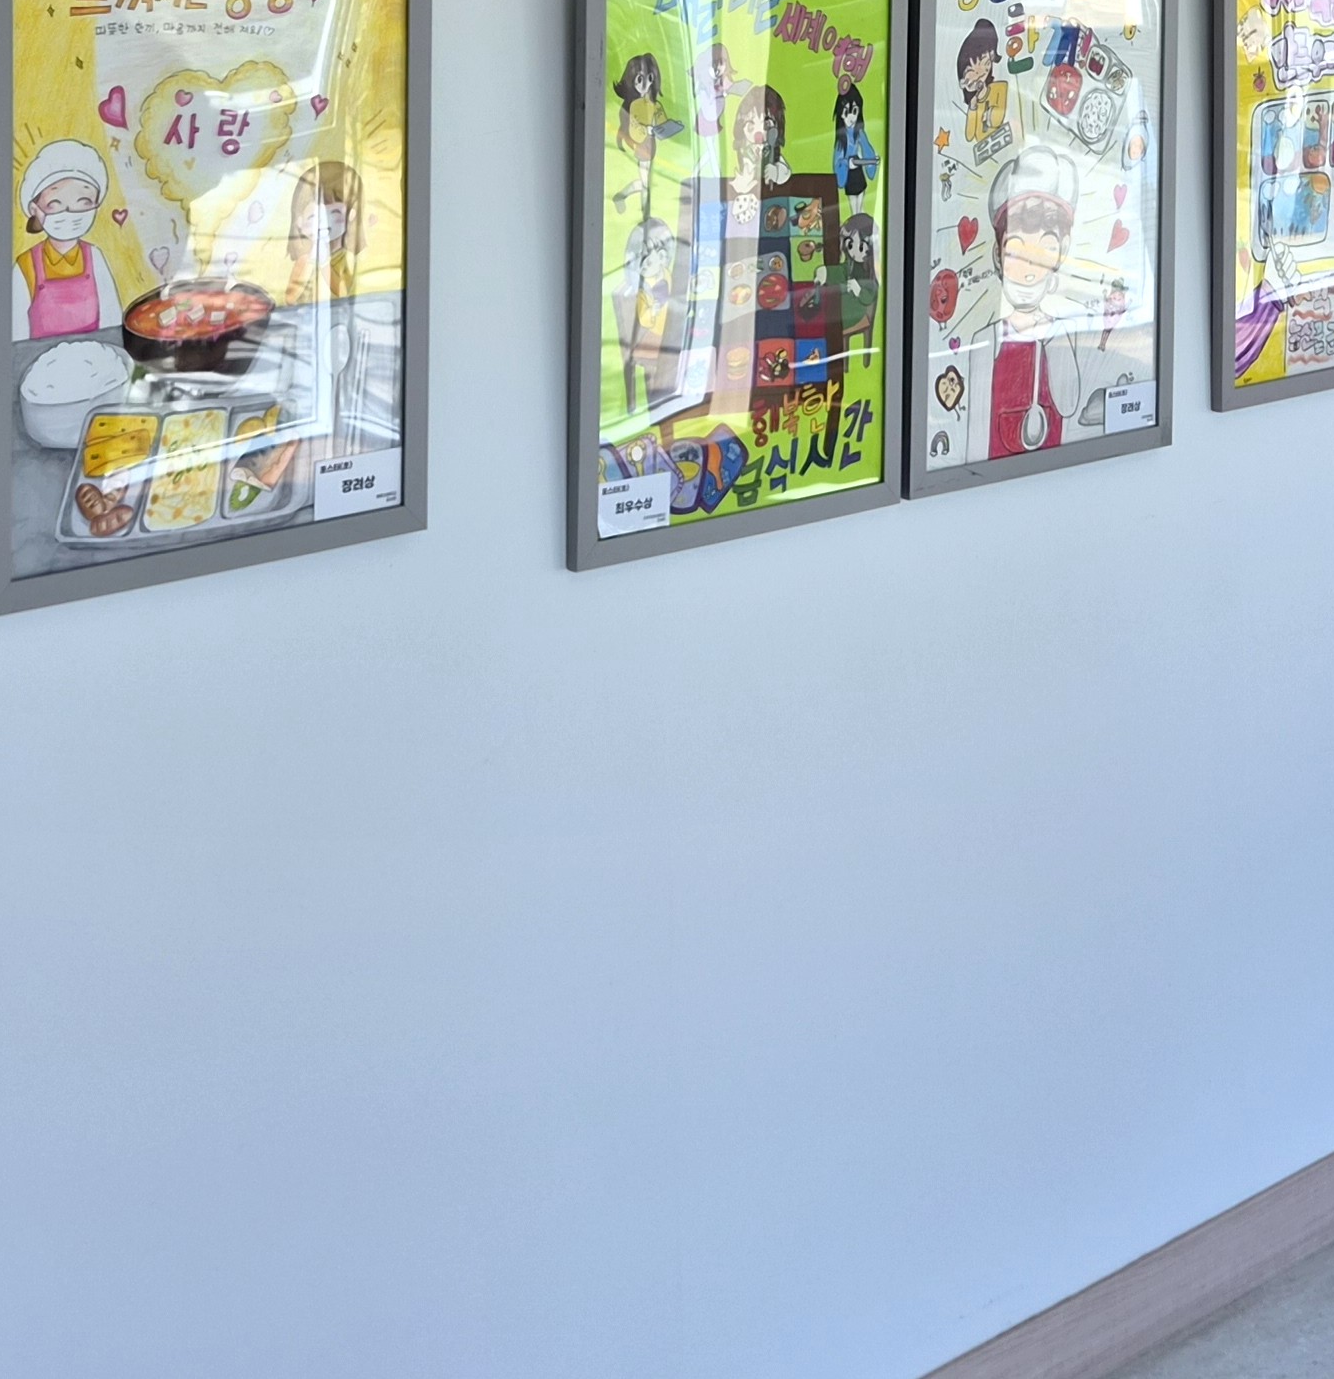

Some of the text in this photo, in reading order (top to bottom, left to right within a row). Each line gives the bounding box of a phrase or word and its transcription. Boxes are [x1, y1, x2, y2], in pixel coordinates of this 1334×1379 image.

[162, 108, 251, 156] 사랑
[750, 379, 841, 448] 행복한
[341, 474, 376, 494] 장려상
[615, 496, 654, 515] 최우수상
